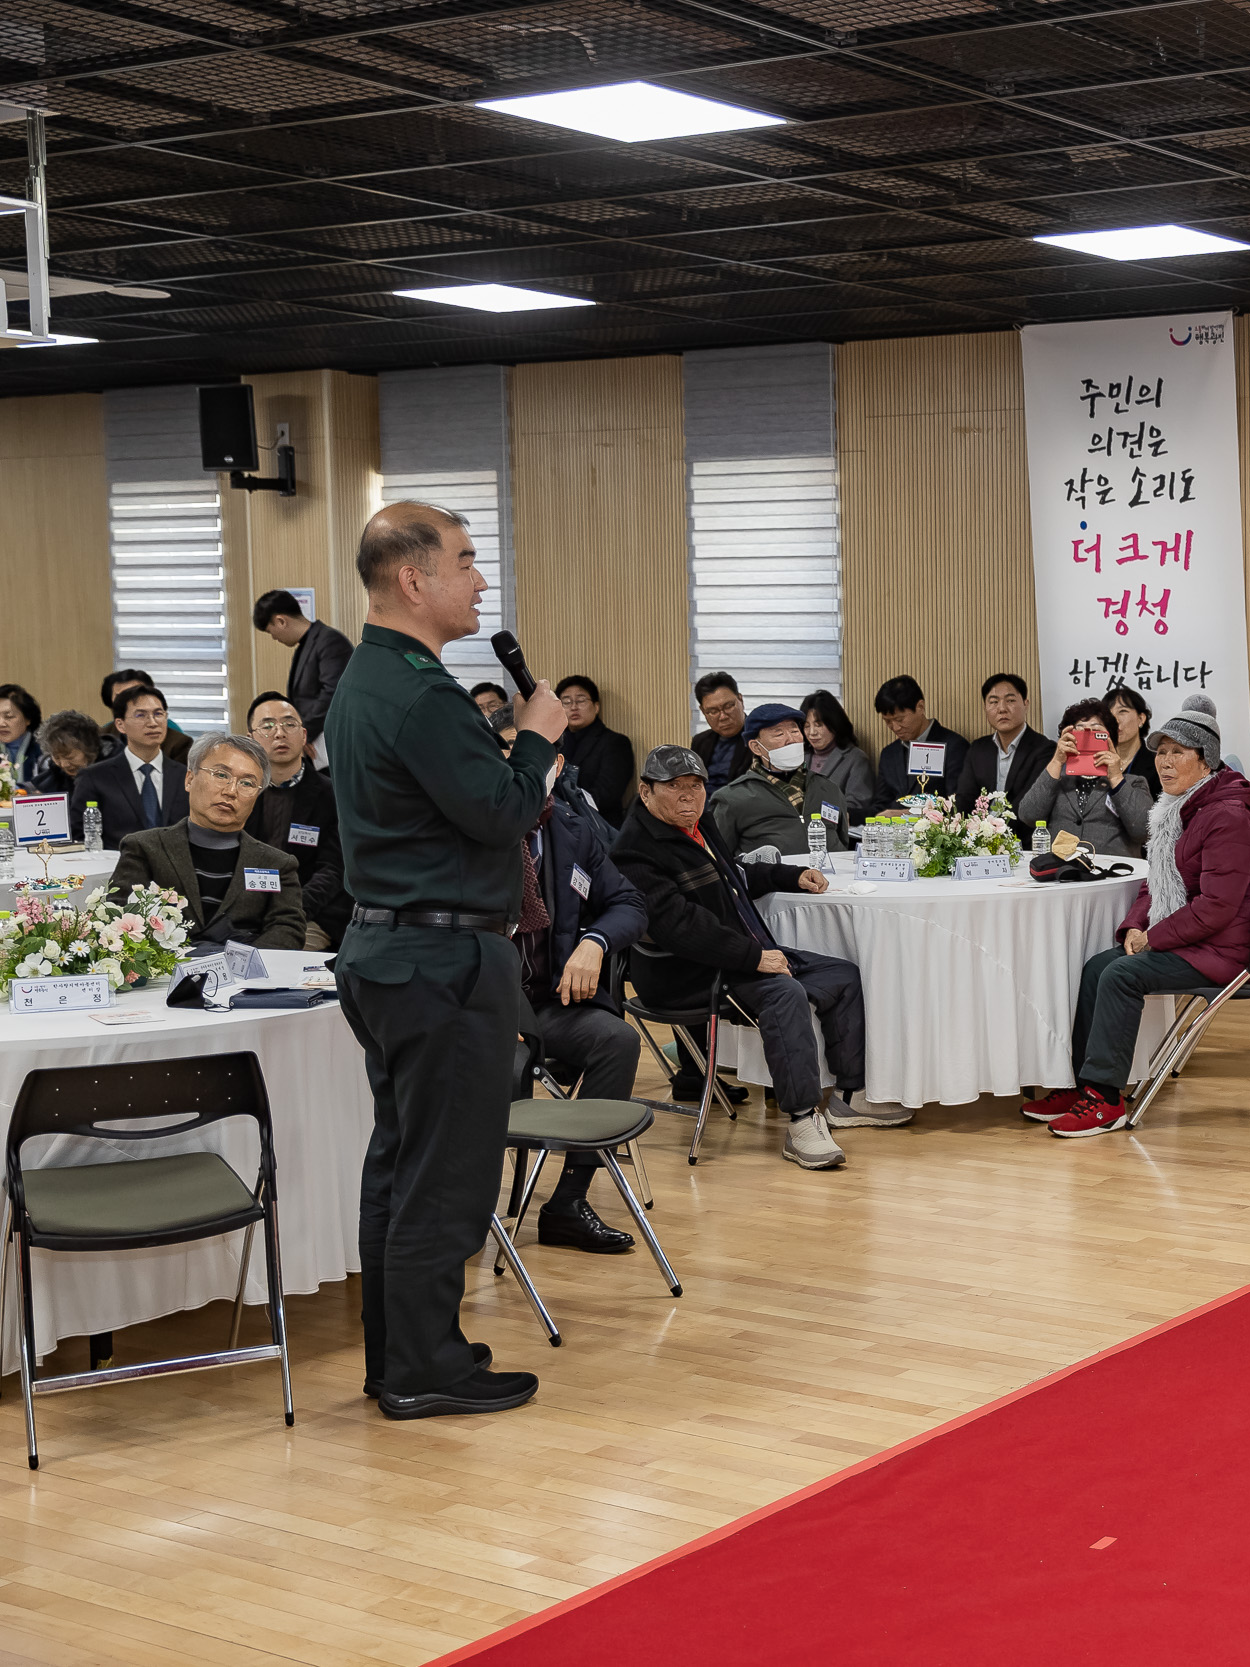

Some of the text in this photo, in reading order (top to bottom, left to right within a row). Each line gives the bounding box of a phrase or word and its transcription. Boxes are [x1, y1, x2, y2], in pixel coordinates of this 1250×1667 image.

[1080, 375, 1163, 418] 주민의
[1087, 422, 1168, 458] 의견은
[1064, 466, 1197, 509] 작은 소리도
[1071, 530, 1194, 573] 더 크게
[1097, 584, 1171, 635] 경청
[1068, 652, 1213, 692] 하겠습니다
[925, 752, 930, 764] 1
[36, 809, 47, 827] 2
